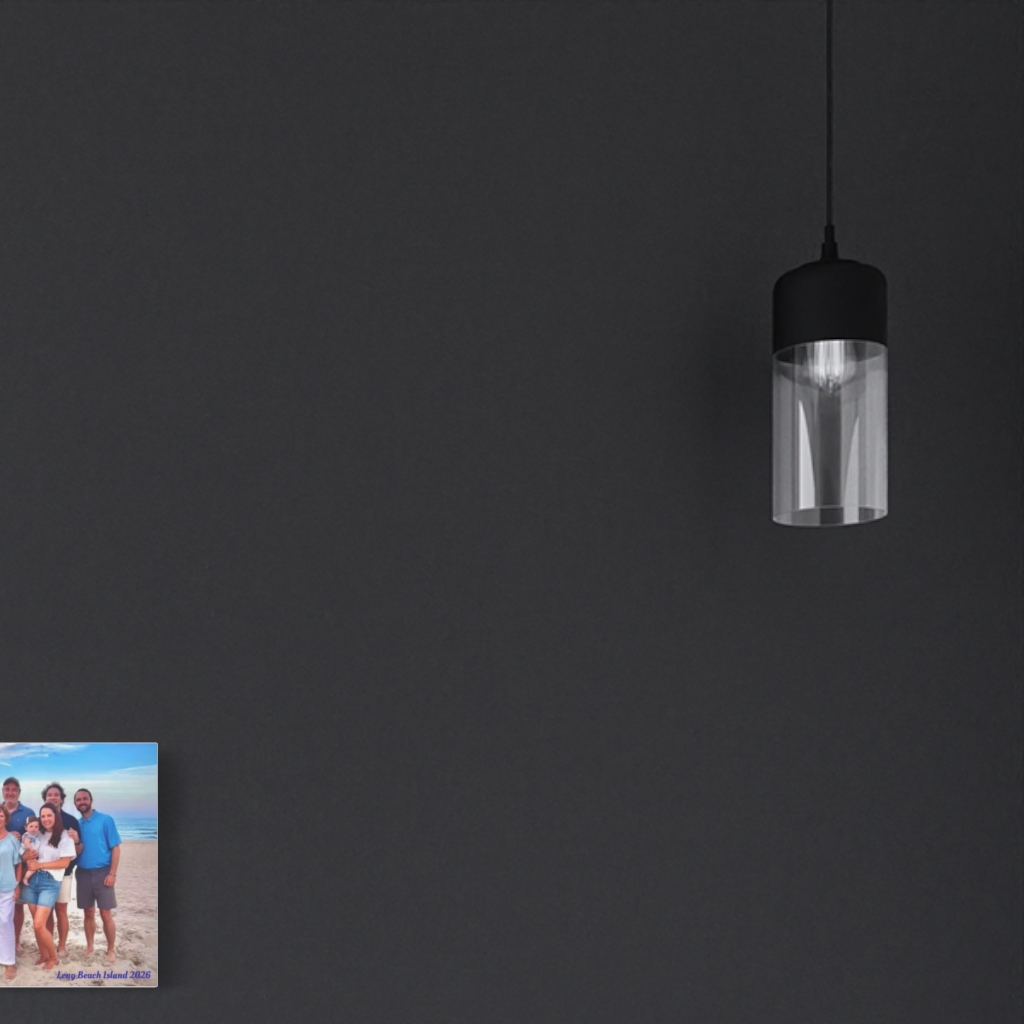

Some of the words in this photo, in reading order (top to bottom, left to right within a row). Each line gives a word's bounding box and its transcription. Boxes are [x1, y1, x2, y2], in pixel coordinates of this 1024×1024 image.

[56, 971, 76, 981] Long
[77, 971, 101, 979] Beach
[103, 971, 128, 979] Island
[129, 971, 151, 979] 2026
